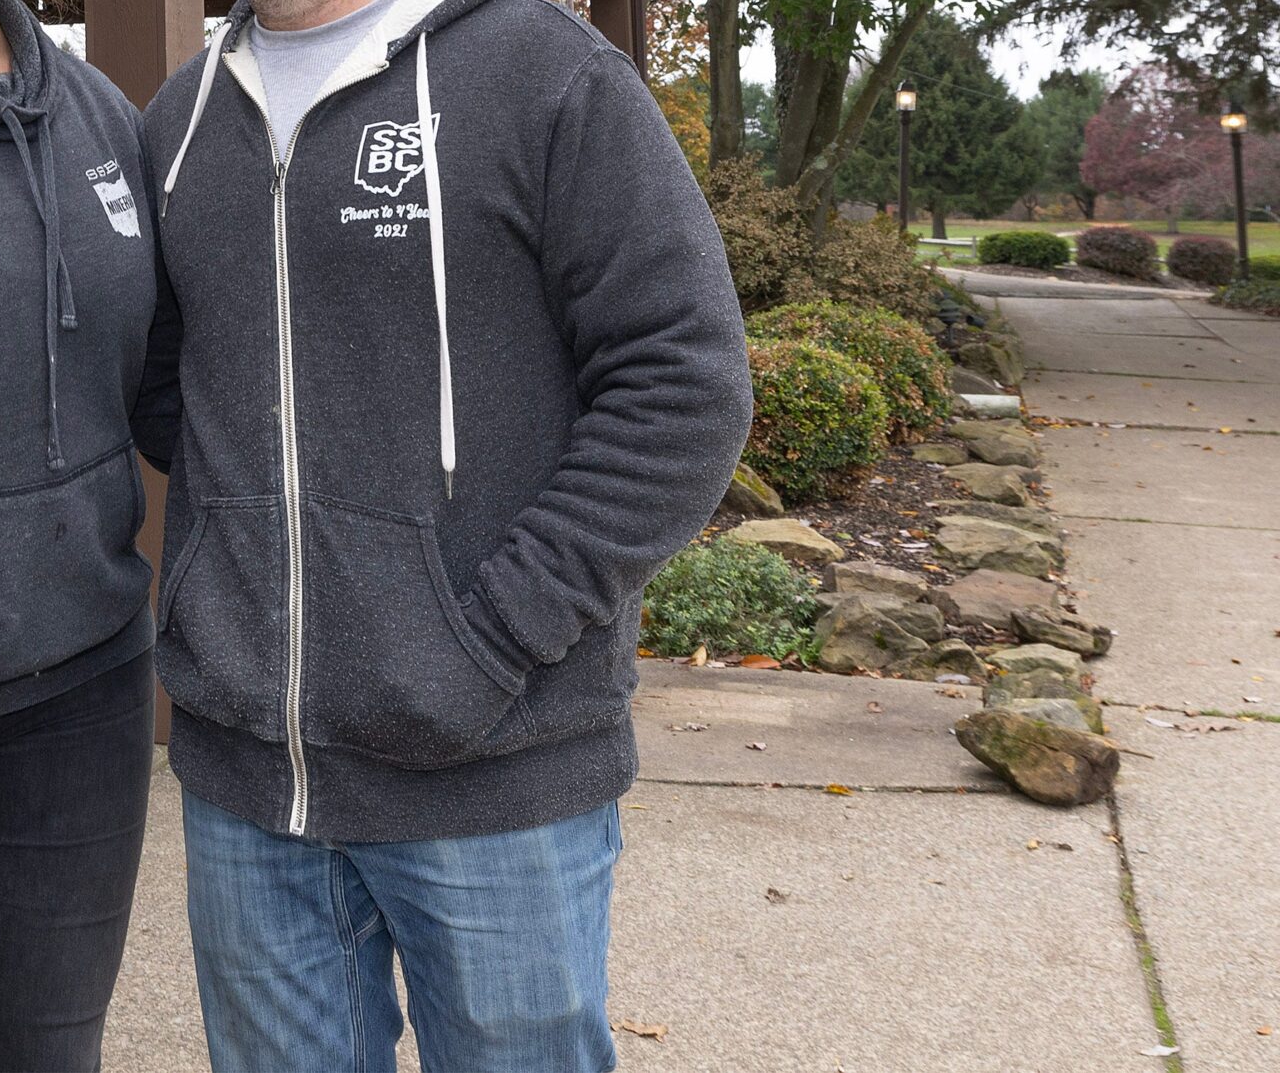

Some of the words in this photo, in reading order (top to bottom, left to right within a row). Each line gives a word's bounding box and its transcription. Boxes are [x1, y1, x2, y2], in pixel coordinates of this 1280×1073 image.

[370, 127, 422, 150] SS
[85, 156, 120, 181] SSB
[367, 149, 420, 173] BC
[340, 207, 379, 224] Cheers
[380, 205, 393, 218] to
[373, 224, 408, 238] 2021
